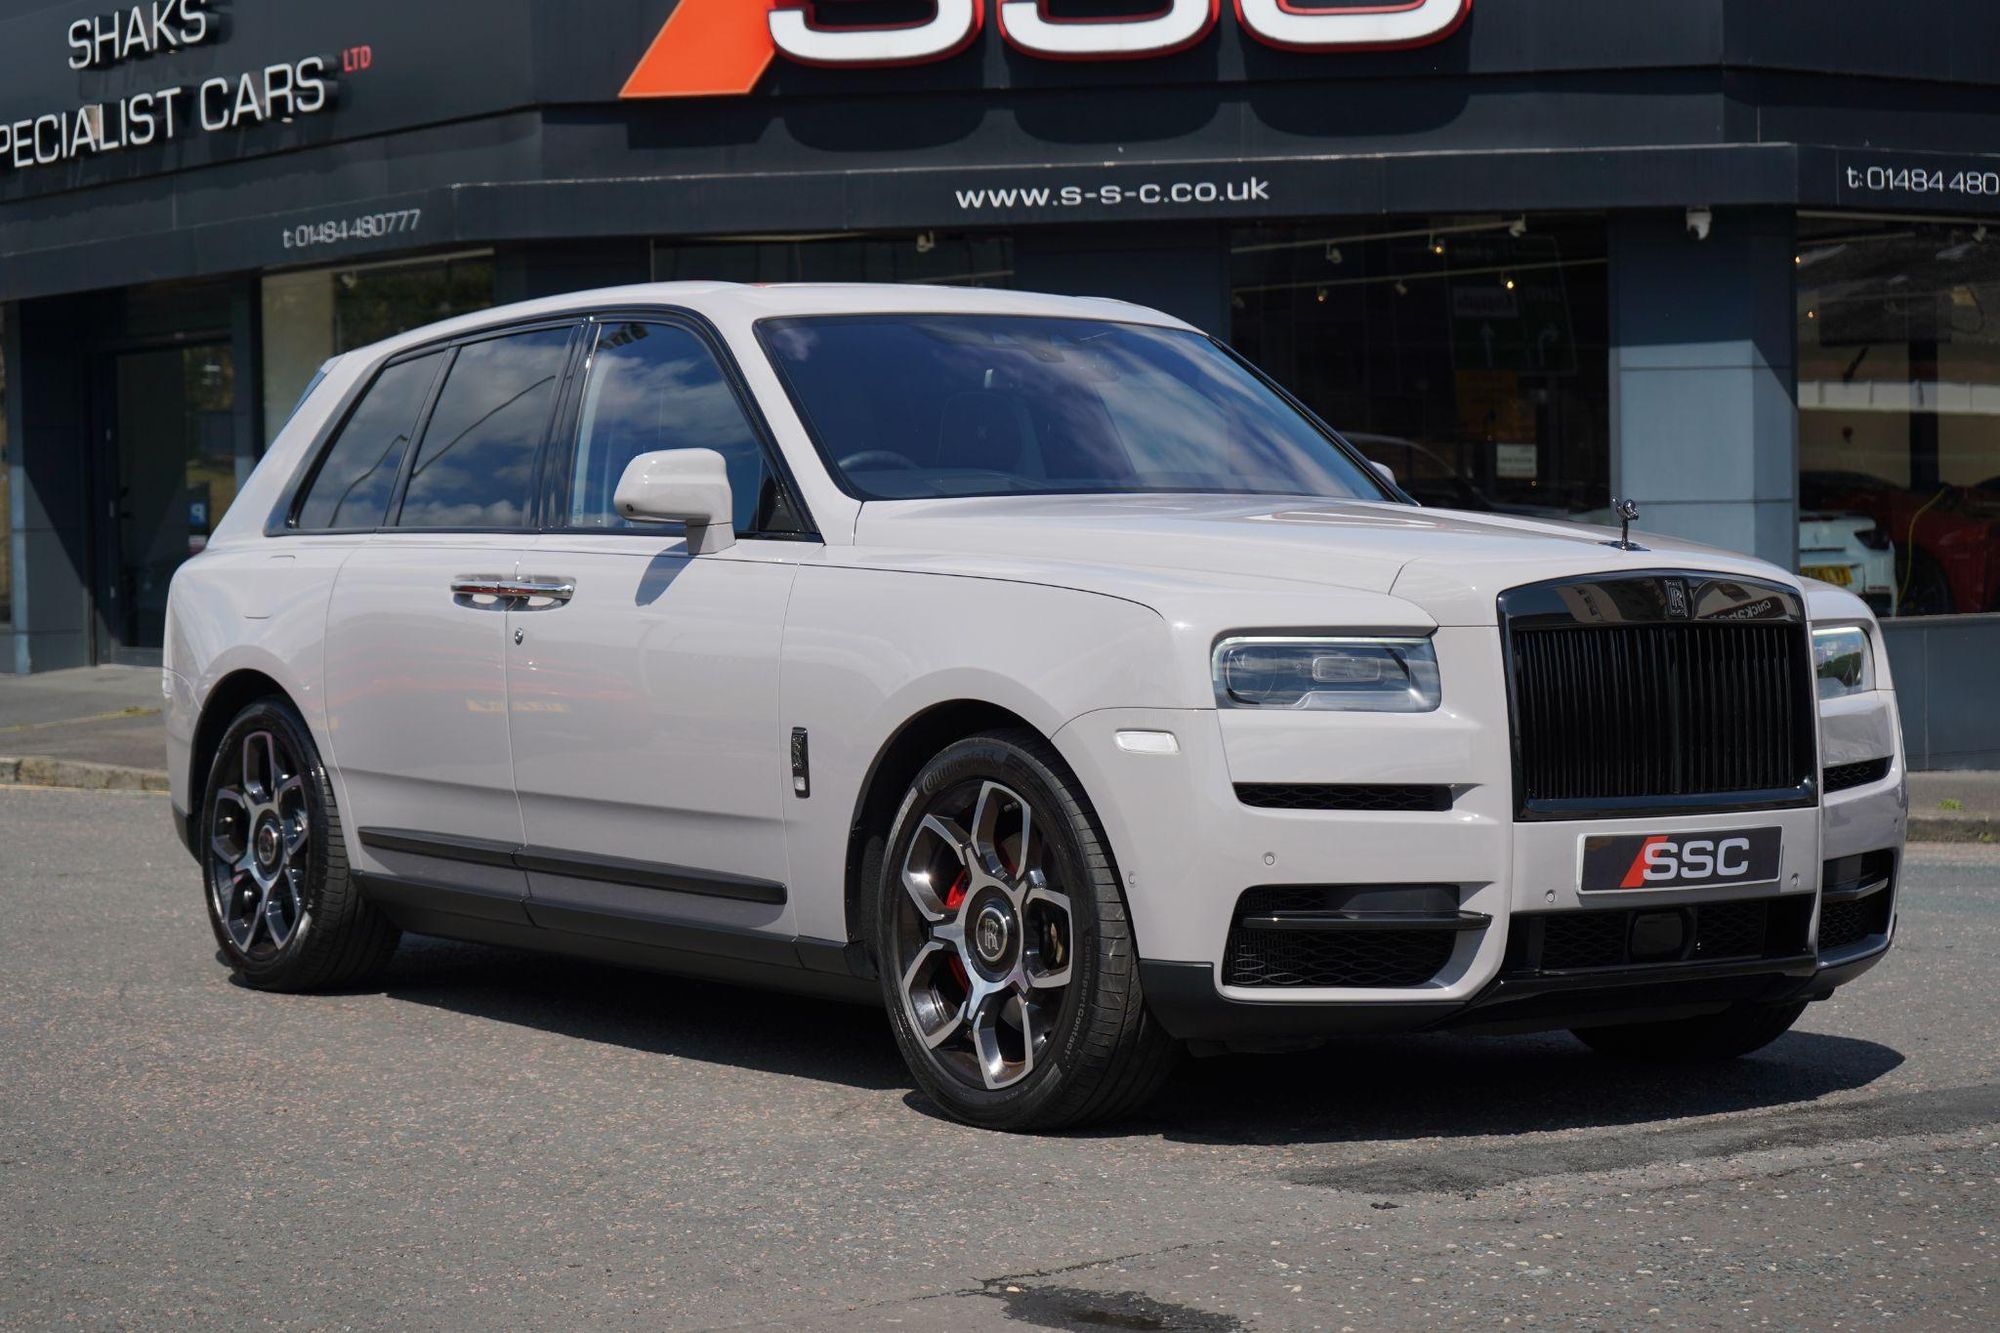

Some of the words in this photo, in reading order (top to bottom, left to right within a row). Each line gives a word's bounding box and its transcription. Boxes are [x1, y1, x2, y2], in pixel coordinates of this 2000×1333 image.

[68, 0, 207, 69] SHAKS
[200, 57, 325, 131] CARS
[343, 45, 372, 73] LTD
[955, 176, 1270, 208] www.s-s-c.co.uk
[1642, 837, 1750, 881] SSC
